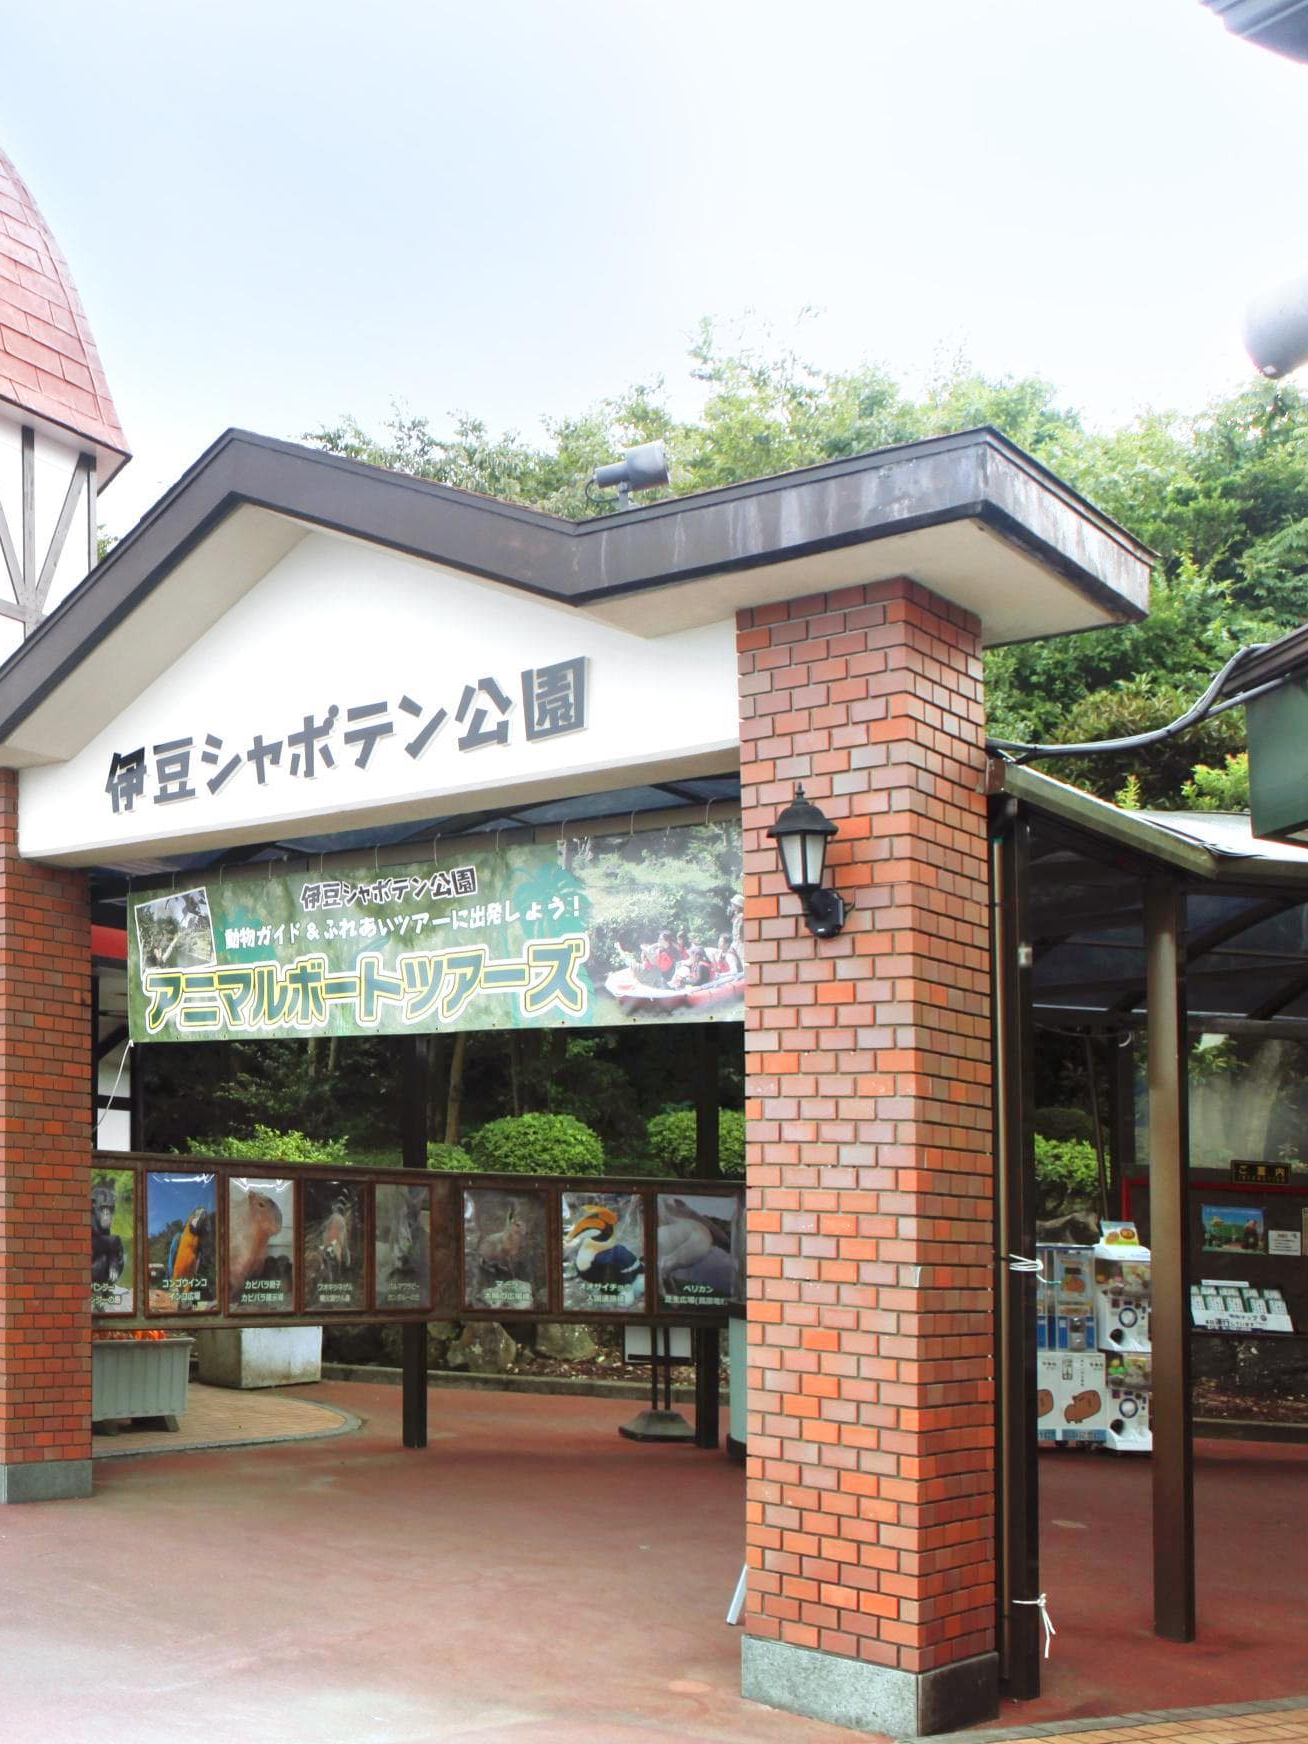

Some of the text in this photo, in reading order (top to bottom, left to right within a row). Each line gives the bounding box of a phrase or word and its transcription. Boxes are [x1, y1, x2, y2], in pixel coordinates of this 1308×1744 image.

[105, 656, 590, 814] 伊豆シャボテン公園
[300, 866, 477, 913] 伊豆シャボテン公園
[145, 935, 588, 1033] アニマルボートツアーズ
[162, 1278, 208, 1289] コンゴウインコ
[683, 1284, 714, 1294] ペリカン
